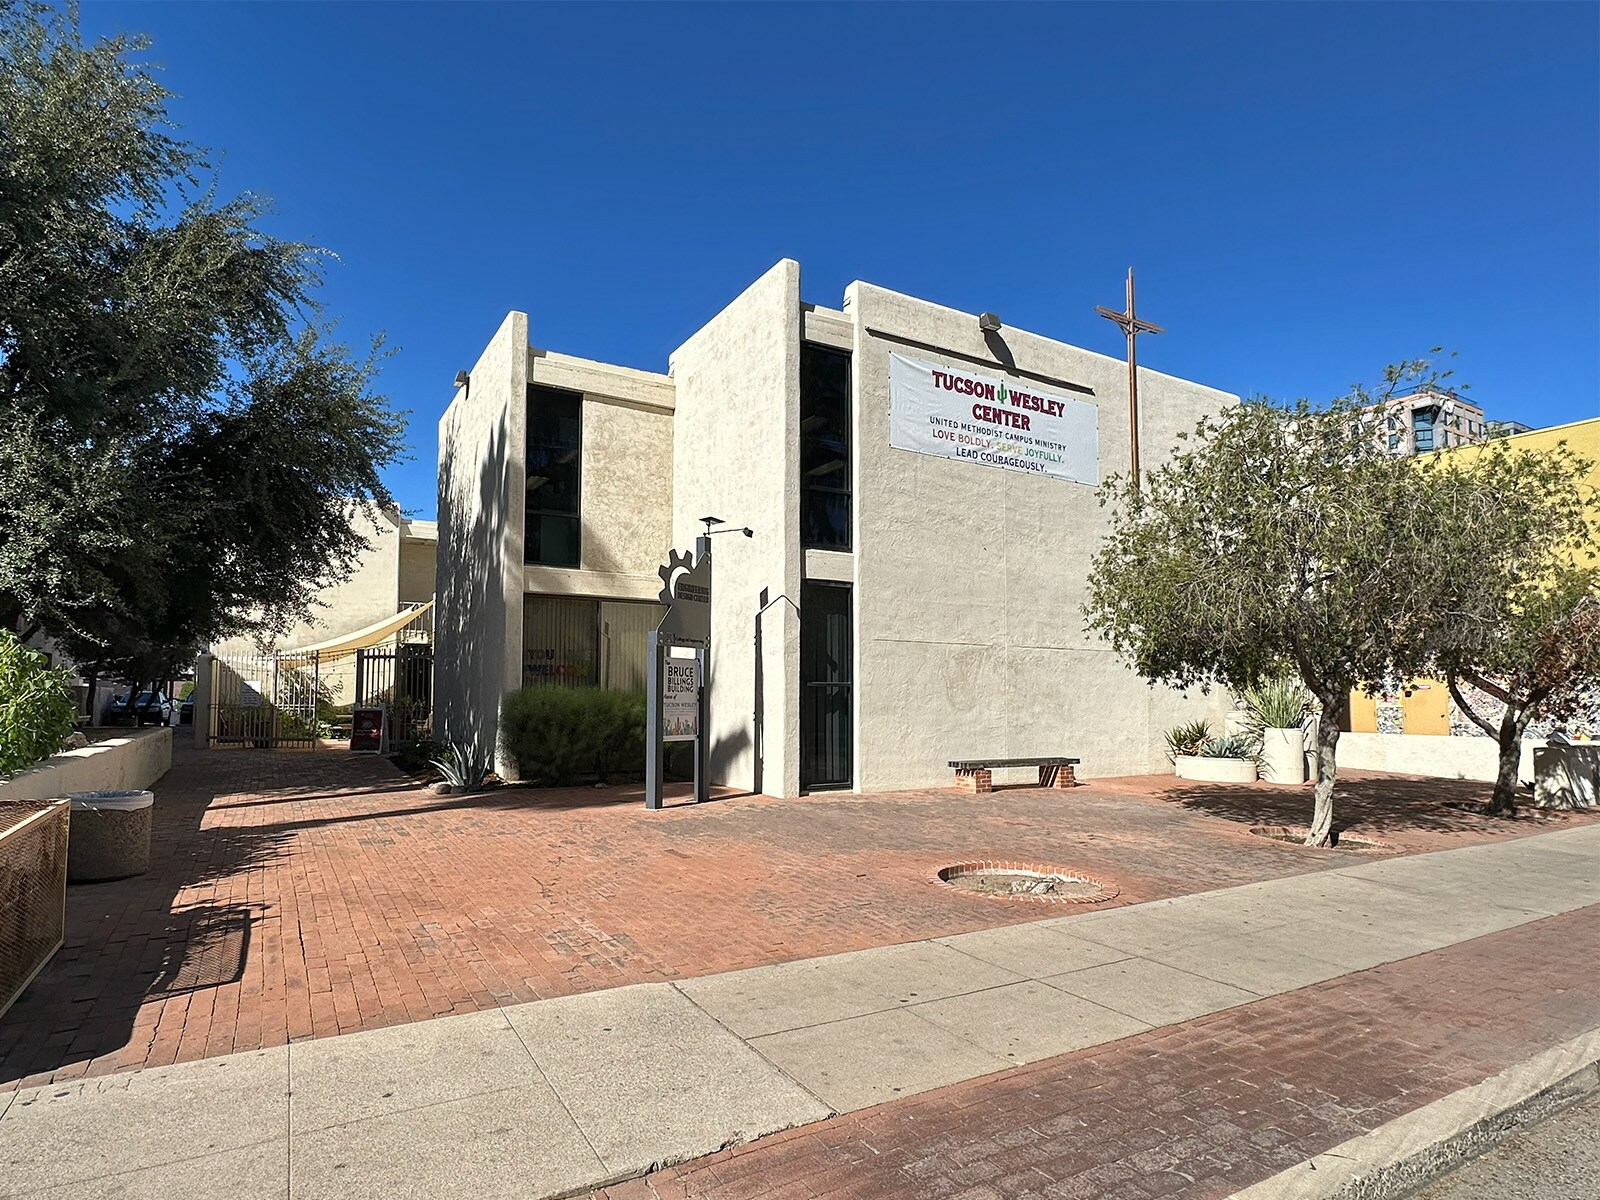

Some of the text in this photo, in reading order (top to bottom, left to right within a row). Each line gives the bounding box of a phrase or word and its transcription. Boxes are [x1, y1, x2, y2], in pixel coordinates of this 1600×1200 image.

[932, 370, 1065, 417] TUCSON WESLEY
[972, 404, 1031, 431] CENTER
[929, 416, 1067, 452] UNITED METHODIST CAMPUS MINISTRY
[932, 429, 1065, 463] LOVE BOLDLY. SERVE JOYFULLY.
[956, 447, 1048, 473] LEAD COURAGEOUSLY.
[527, 649, 555, 660] YOU
[668, 666, 693, 677] BRUCE
[668, 677, 693, 686] BILLINGS
